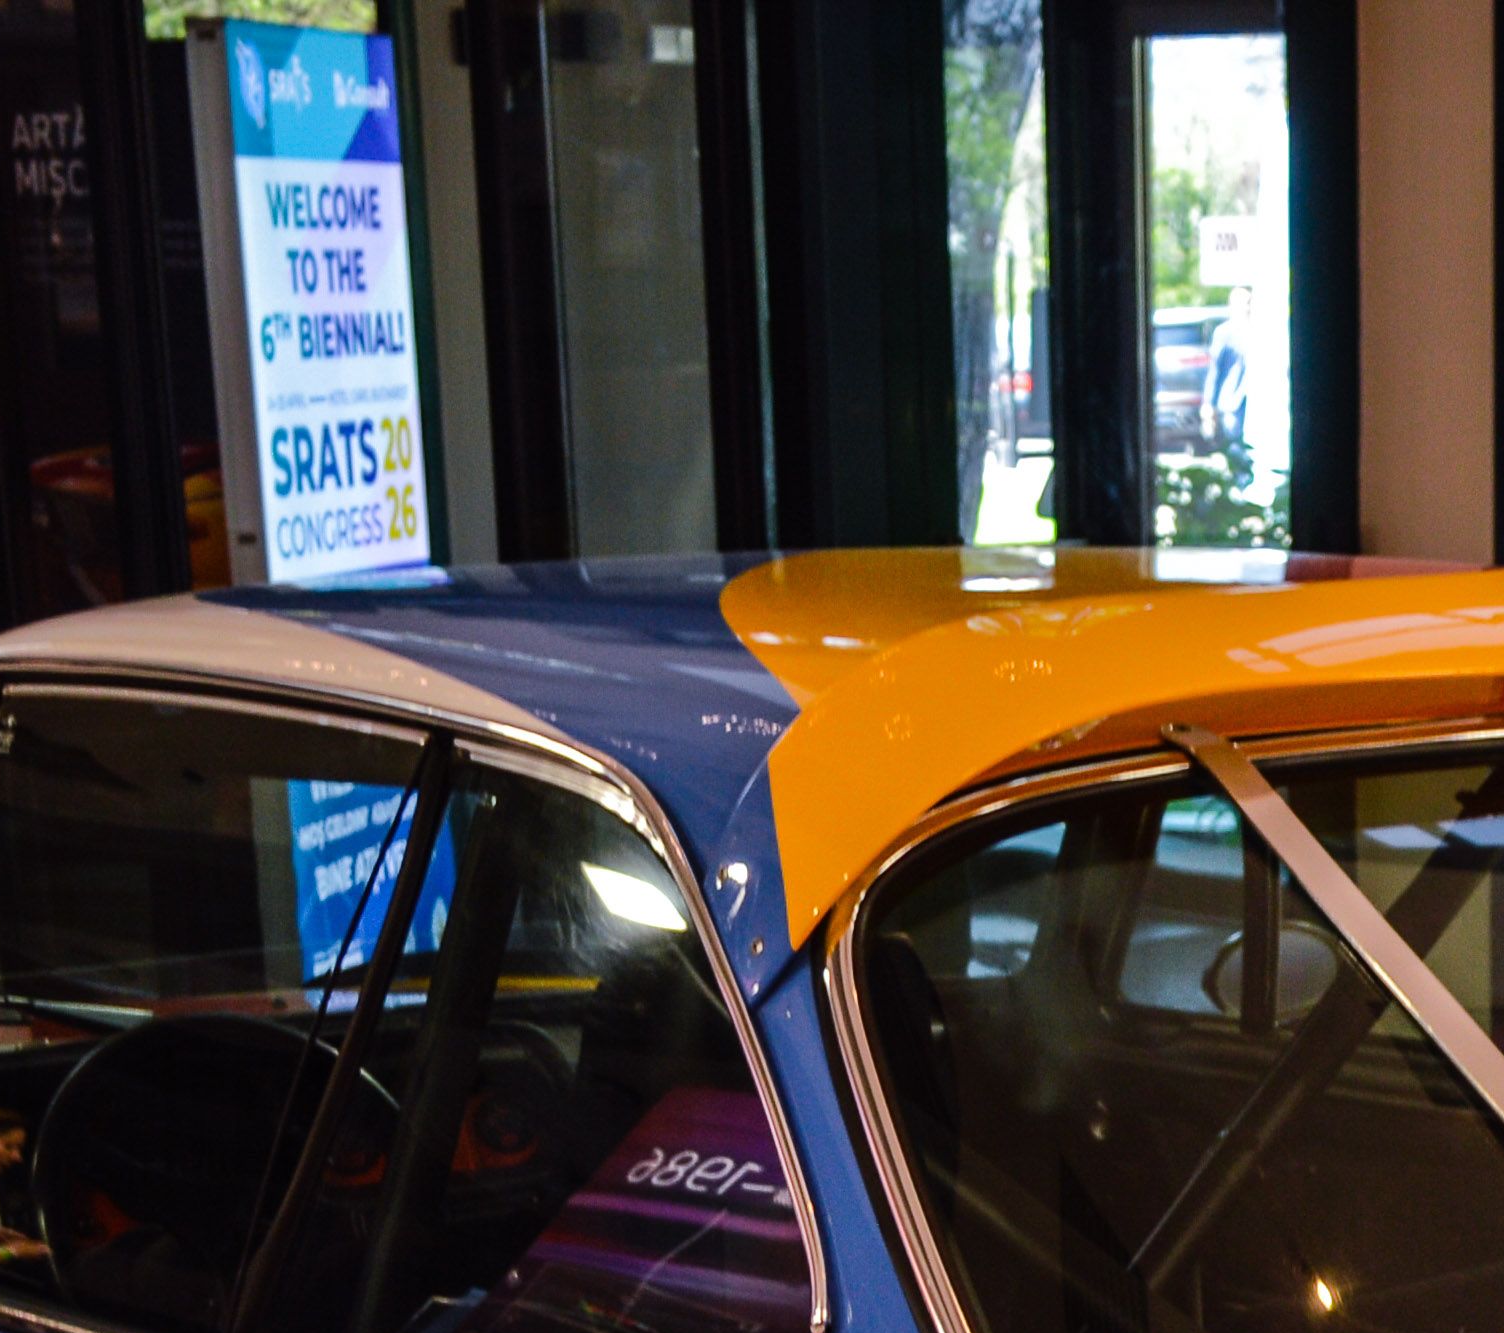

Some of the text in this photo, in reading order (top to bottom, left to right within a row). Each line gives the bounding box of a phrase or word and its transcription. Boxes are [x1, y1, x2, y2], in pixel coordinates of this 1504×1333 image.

[265, 182, 381, 230] WELCOME
[286, 249, 366, 294] TO THE
[298, 311, 405, 359] BIENNIAL!
[271, 416, 412, 497] SRATS 20
[277, 483, 417, 559] CONGRESS 26
